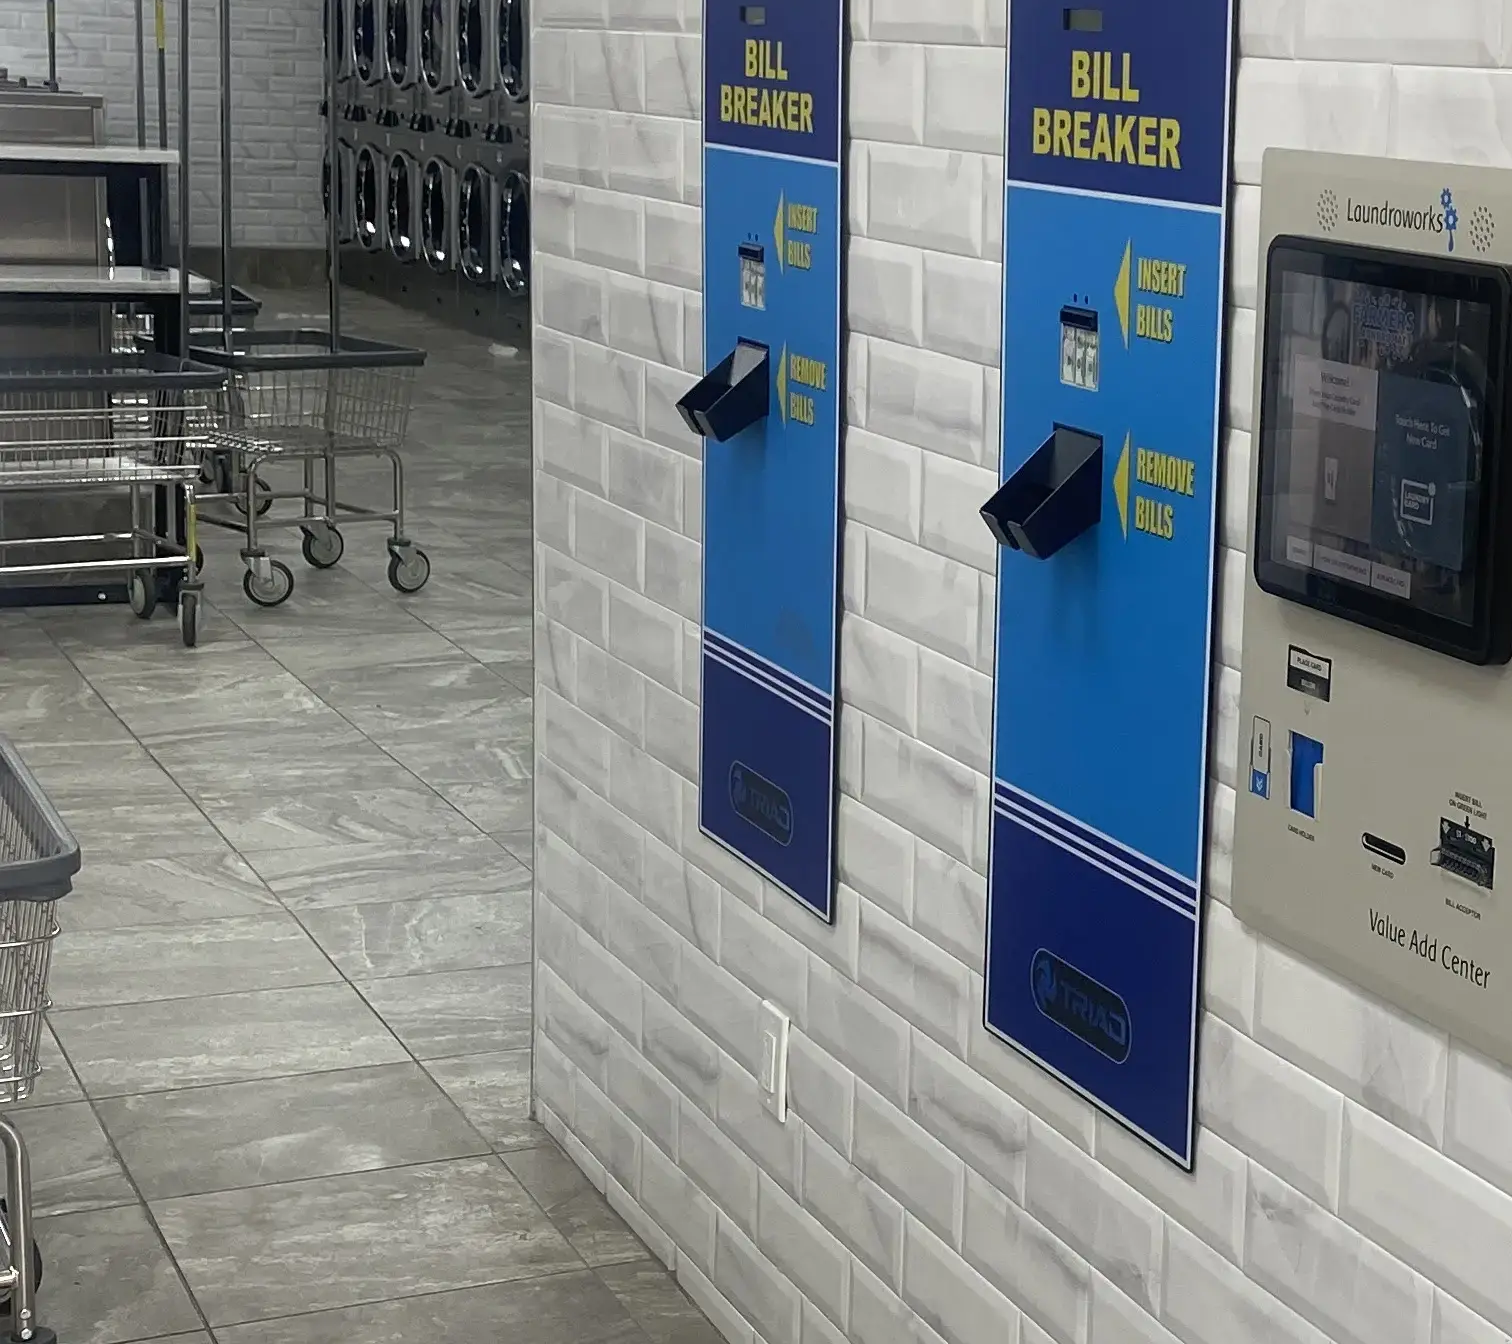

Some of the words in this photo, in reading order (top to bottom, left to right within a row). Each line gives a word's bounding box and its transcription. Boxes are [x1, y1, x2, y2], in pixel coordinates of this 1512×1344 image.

[745, 39, 788, 80] BILL
[1071, 50, 1139, 102] BILL
[720, 84, 813, 133] BREAKER
[1033, 107, 1181, 170] BREAKER
[787, 203, 818, 234] INSERT
[1347, 197, 1443, 233] Laundroworks
[787, 239, 812, 271] BILLS
[1137, 256, 1187, 298] INSERT
[1136, 303, 1174, 344] BILLS
[789, 353, 828, 391] REMOVE
[789, 392, 814, 426] BILLS
[1136, 447, 1196, 498] REMOVE
[1135, 495, 1175, 541] BILLS
[1369, 908, 1406, 948] Value
[1408, 929, 1438, 963] Add
[1441, 945, 1491, 989] Center
[1060, 978, 1127, 1047] TRIAD
